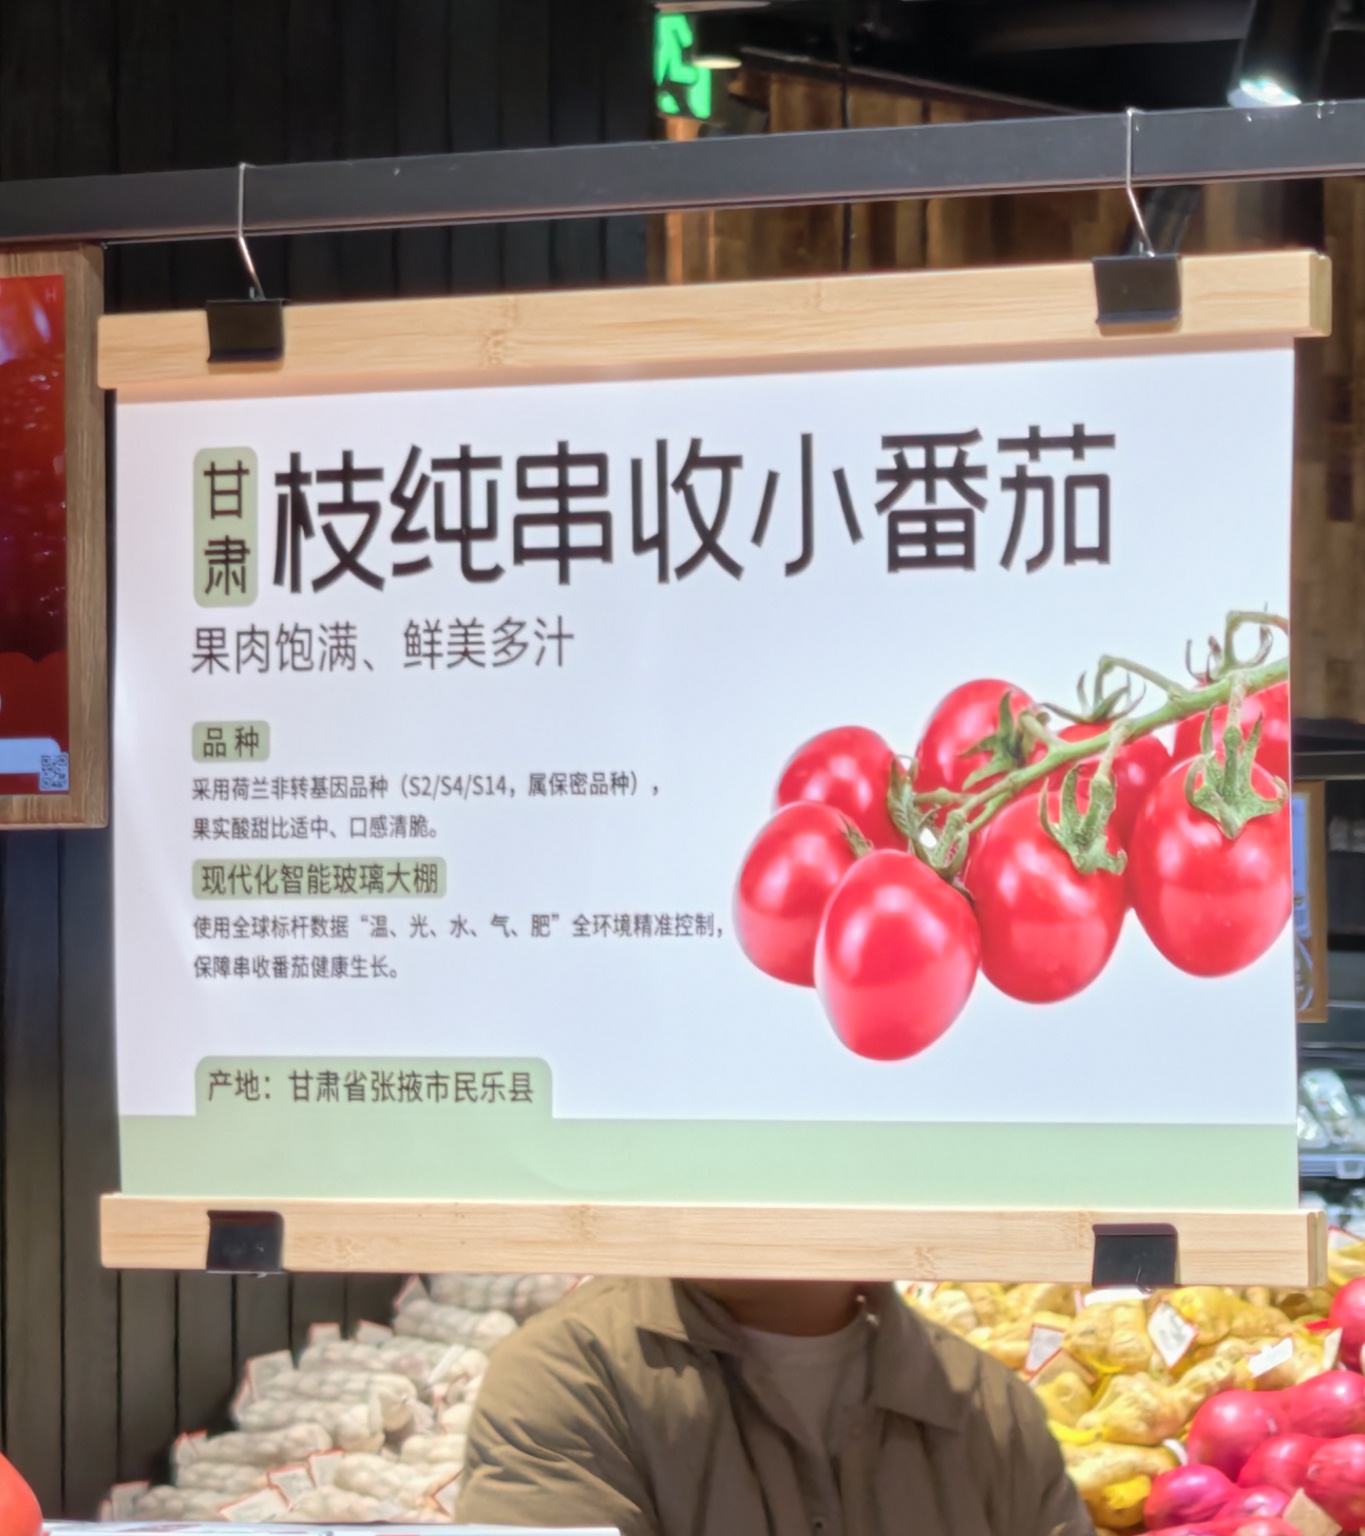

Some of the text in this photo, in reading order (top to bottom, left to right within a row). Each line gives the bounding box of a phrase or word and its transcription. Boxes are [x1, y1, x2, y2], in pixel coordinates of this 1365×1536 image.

[202, 459, 251, 596] 甘肃
[272, 423, 1117, 594] 枝纯串收小番茄
[191, 615, 575, 675] 果肉饱满、鲜美多汁
[202, 725, 260, 759] 品种
[201, 862, 439, 896] 现代化智能玻璃大棚
